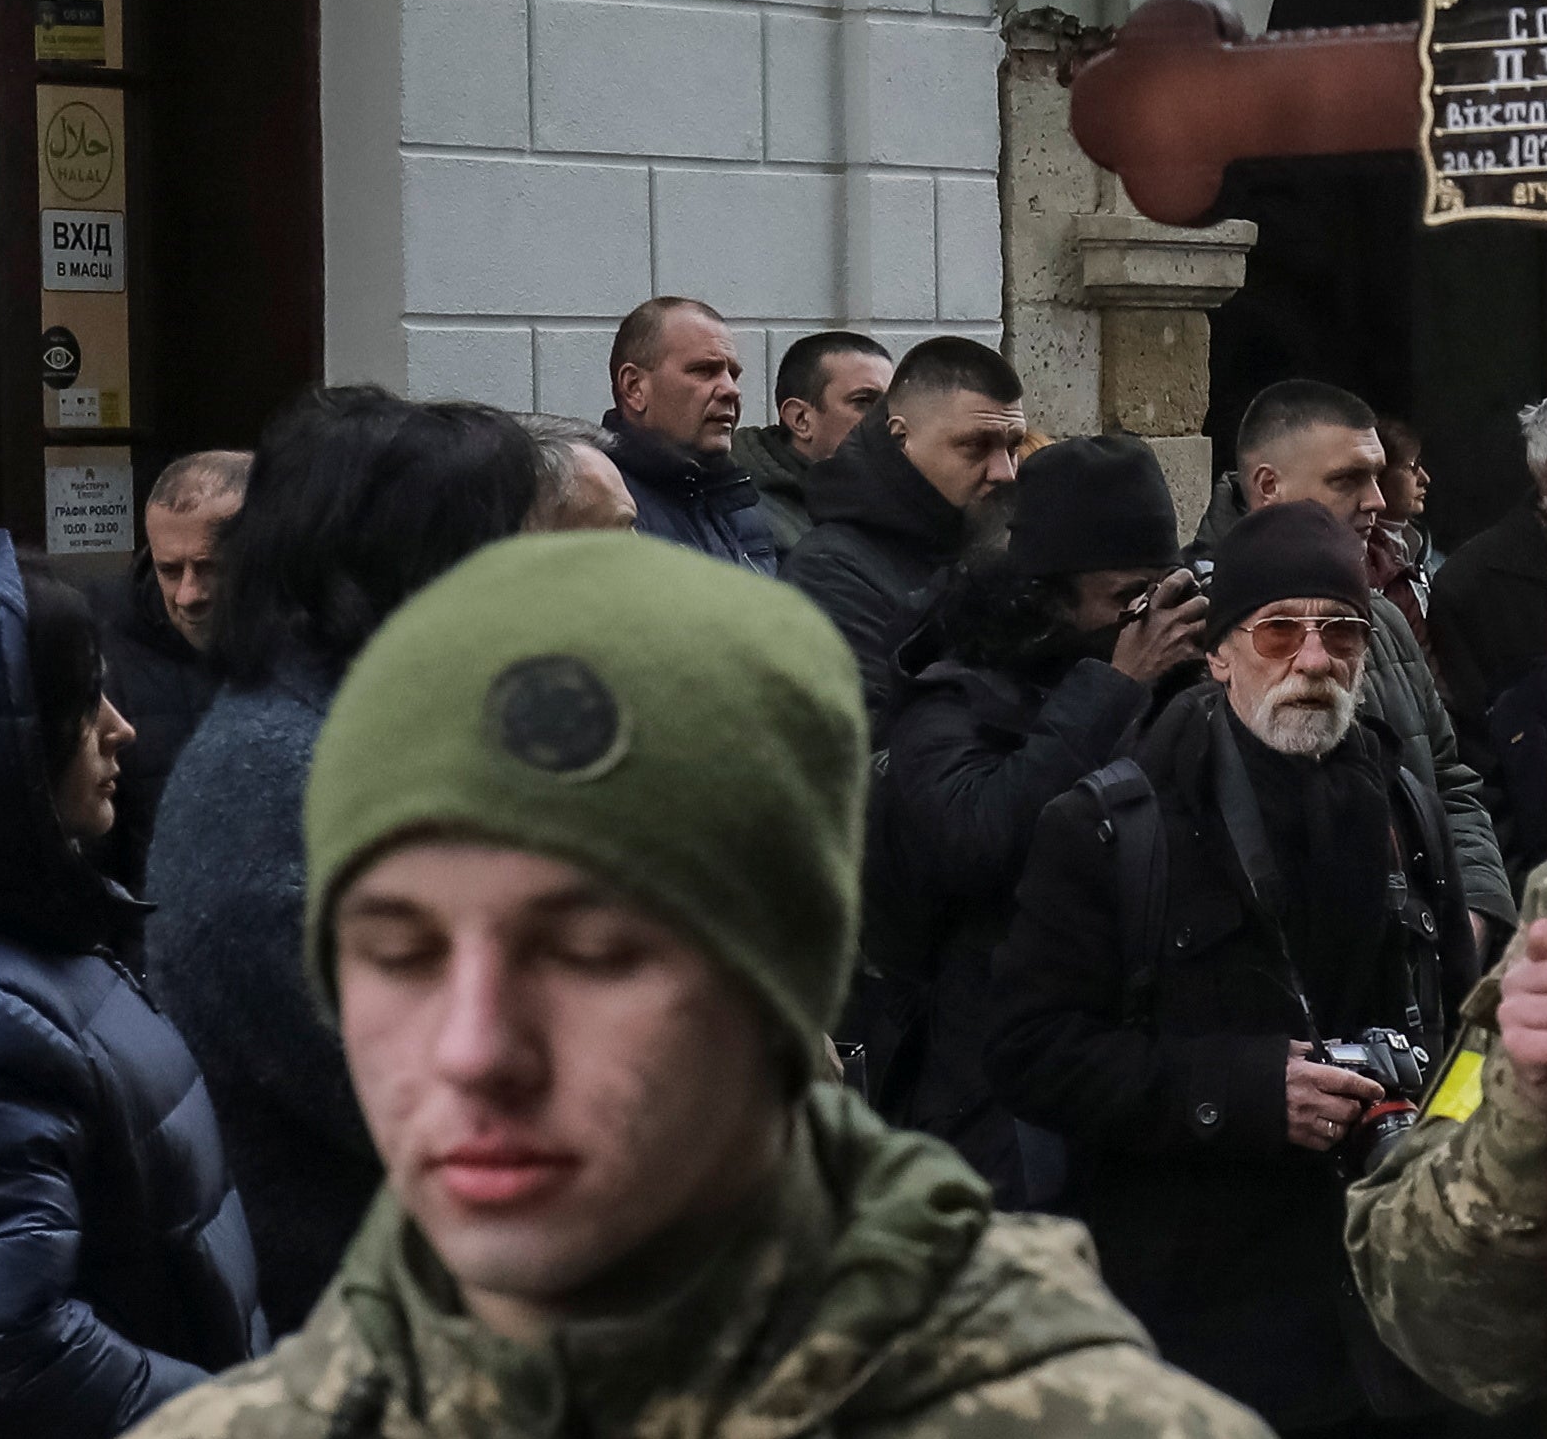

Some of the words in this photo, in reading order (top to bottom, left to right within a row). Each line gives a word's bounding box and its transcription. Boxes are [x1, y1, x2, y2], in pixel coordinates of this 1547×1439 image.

[49, 116, 109, 159] حلال
[58, 167, 102, 182] HALAL
[53, 221, 112, 257] ВХІД
[57, 262, 66, 277] В
[70, 262, 112, 280] МАСЦІ
[89, 504, 127, 516] РОБОТИ
[63, 523, 87, 534] 10:00
[94, 522, 119, 534] 23:00
